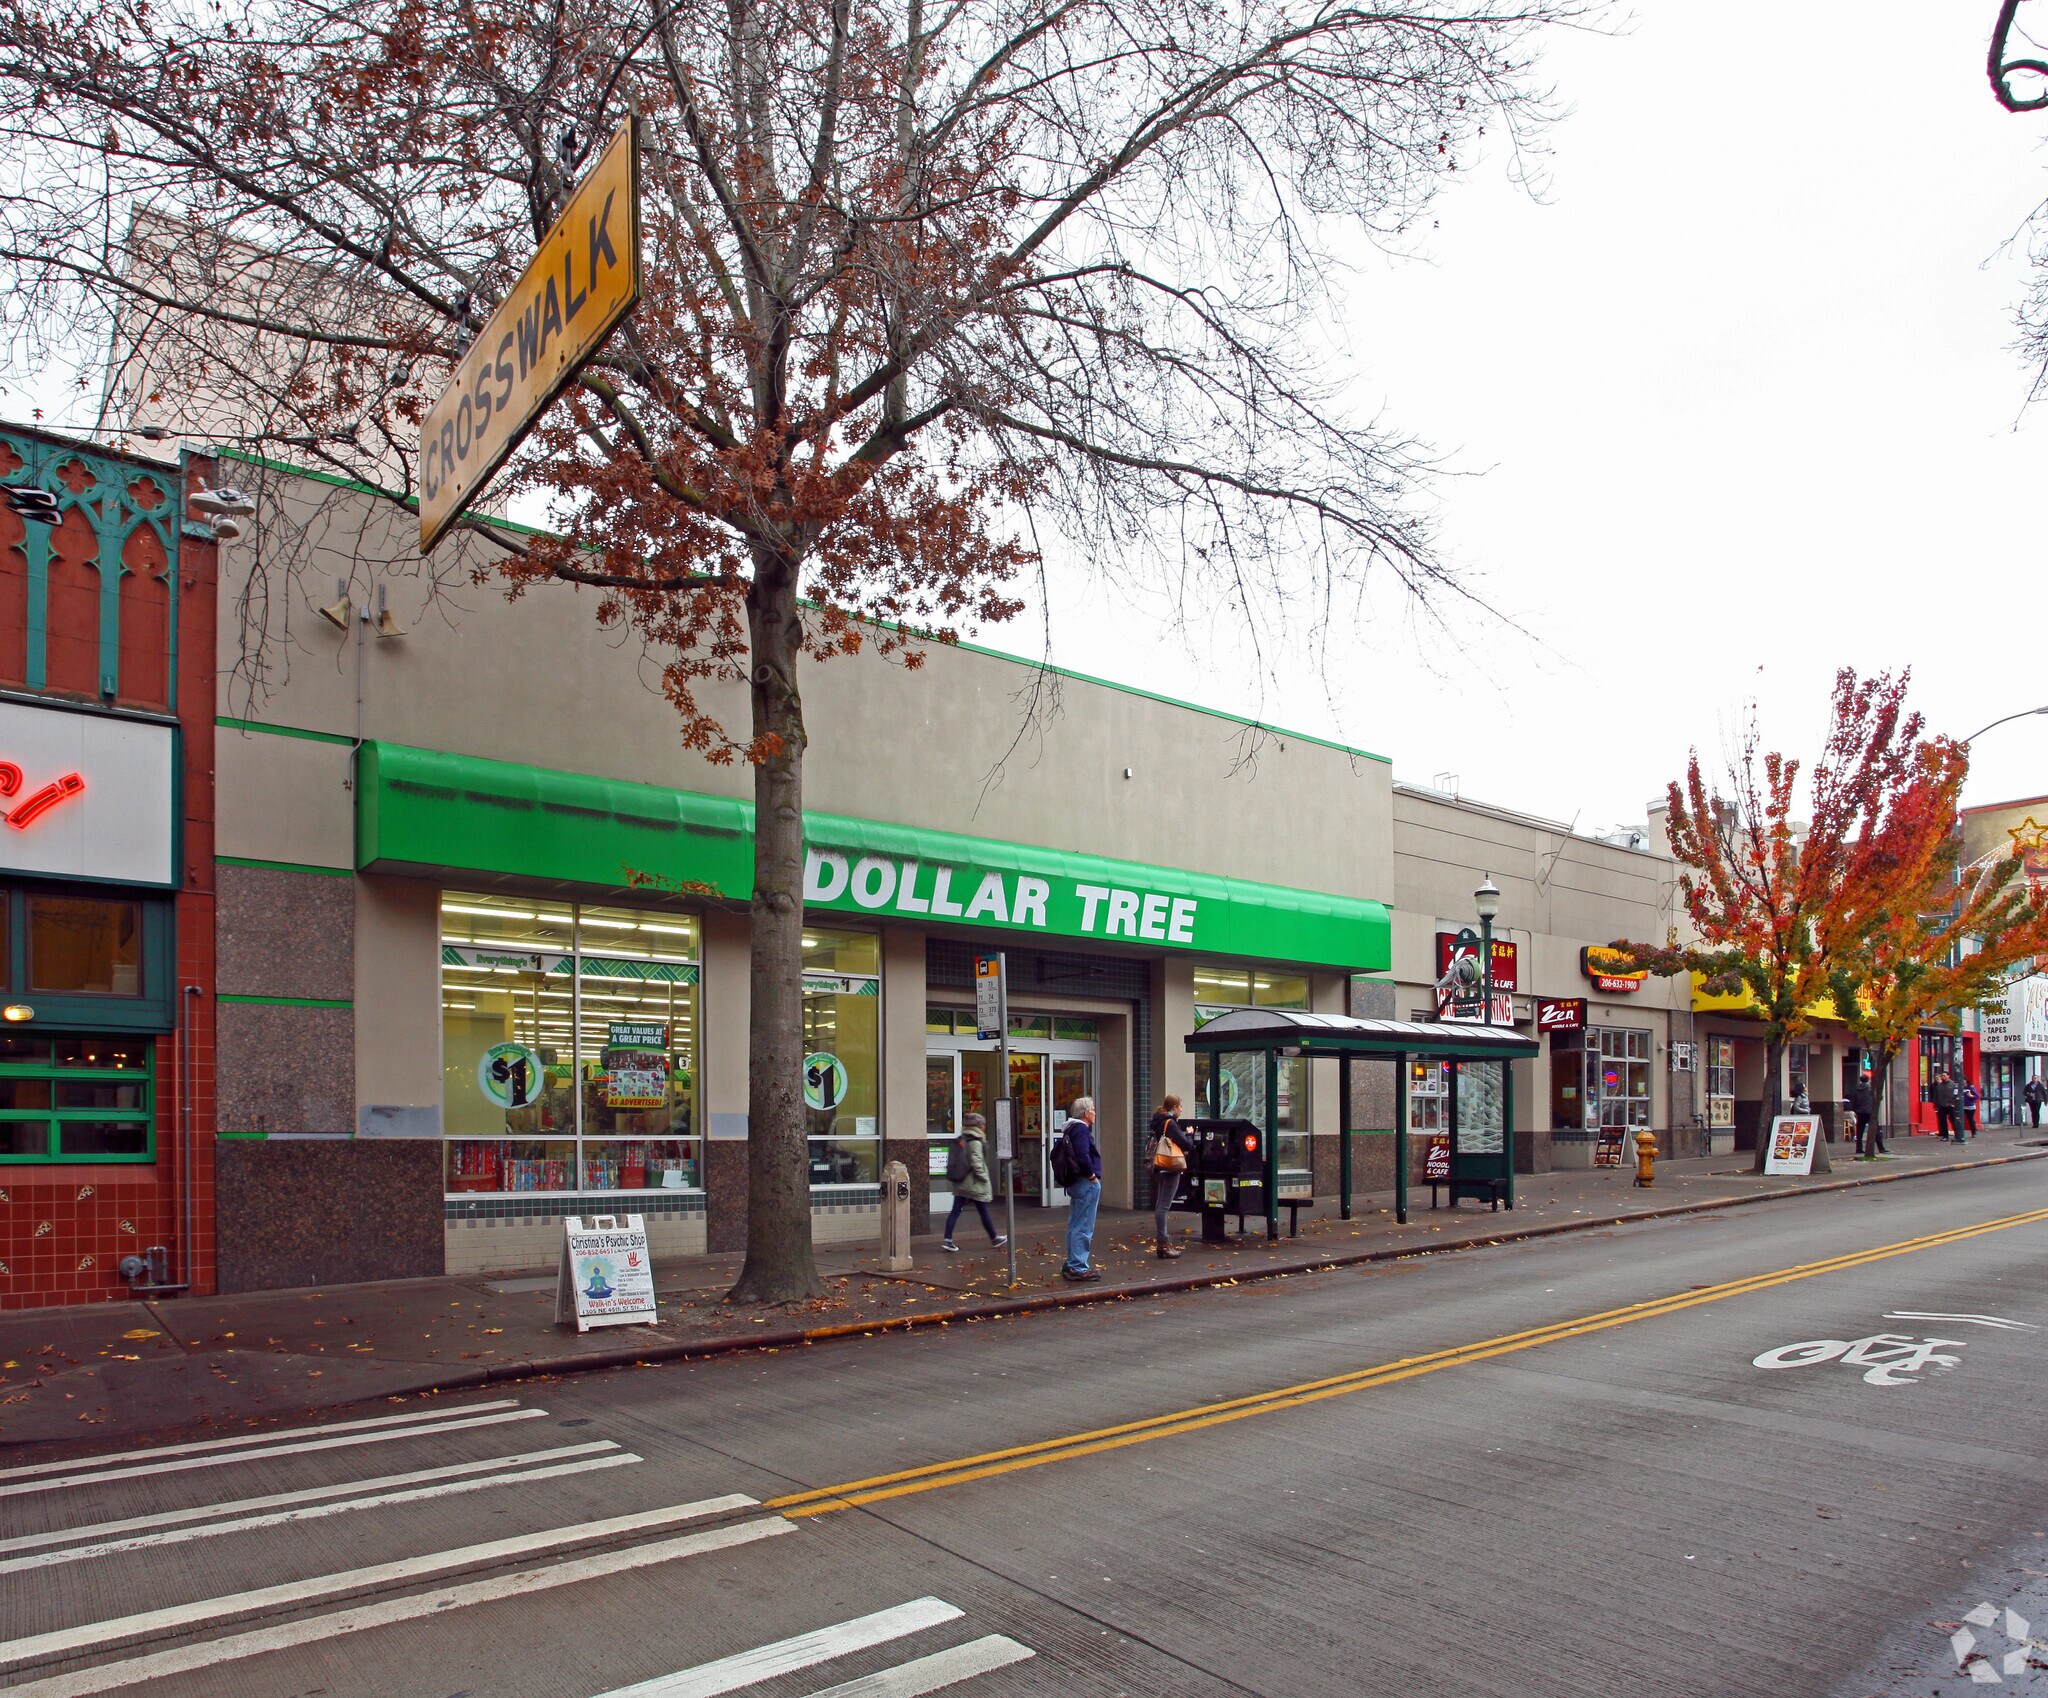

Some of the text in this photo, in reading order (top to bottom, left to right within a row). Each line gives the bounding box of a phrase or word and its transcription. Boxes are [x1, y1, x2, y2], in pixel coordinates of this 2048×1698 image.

[425, 186, 618, 502] CROSSWALK
[803, 847, 1198, 944] DOLLAR TREE
[476, 953, 542, 970] Everything's $1
[841, 978, 850, 992] $1
[1500, 980, 1514, 989] CAFE
[1601, 978, 1637, 990] 206-632-1900
[1540, 1004, 1574, 1024] Zen
[610, 1026, 663, 1036] GREAT VALUES AT
[611, 1035, 662, 1045] A GREAT PRICE
[1987, 1034, 2021, 1043] CDS DVDS
[681, 1059, 687, 1068] 3
[491, 1056, 529, 1107] $1
[807, 1064, 837, 1109] $1
[609, 1098, 662, 1107] AS ADVERTISED!
[572, 1235, 645, 1249] Christina's Psychic Shop
[588, 1297, 645, 1308] Walk-in's Welcome
